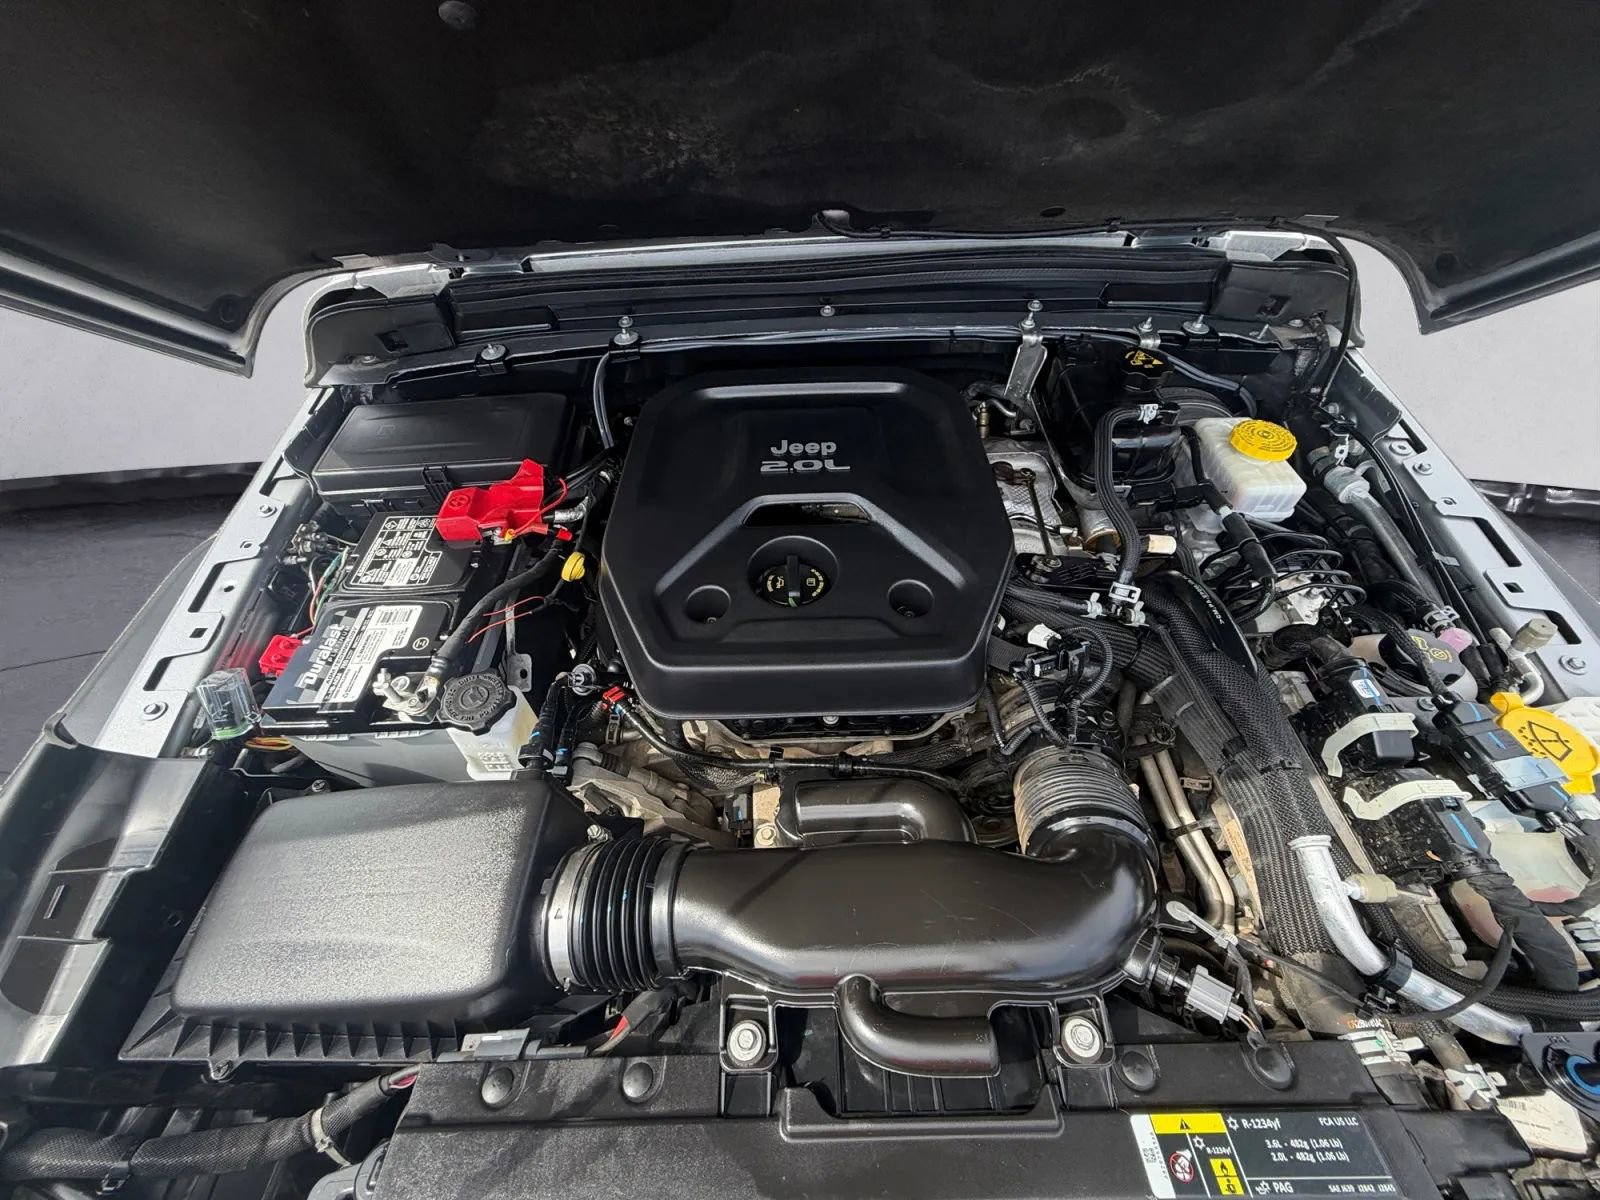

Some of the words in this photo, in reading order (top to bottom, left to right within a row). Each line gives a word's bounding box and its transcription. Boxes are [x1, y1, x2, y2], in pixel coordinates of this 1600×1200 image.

[770, 439, 837, 456] Jeep
[760, 459, 851, 474] 2.0L
[327, 624, 351, 663] PLATINUM
[301, 623, 345, 685] Duralast
[1242, 1117, 1281, 1131] R-1234yf
[1318, 1117, 1333, 1126] FCA
[1333, 1117, 1346, 1126] US
[1345, 1117, 1359, 1126] LLC
[1265, 1139, 1283, 1149] 3.6L
[1270, 1152, 1288, 1162] 2.0L
[1273, 1182, 1294, 1193] PAG
